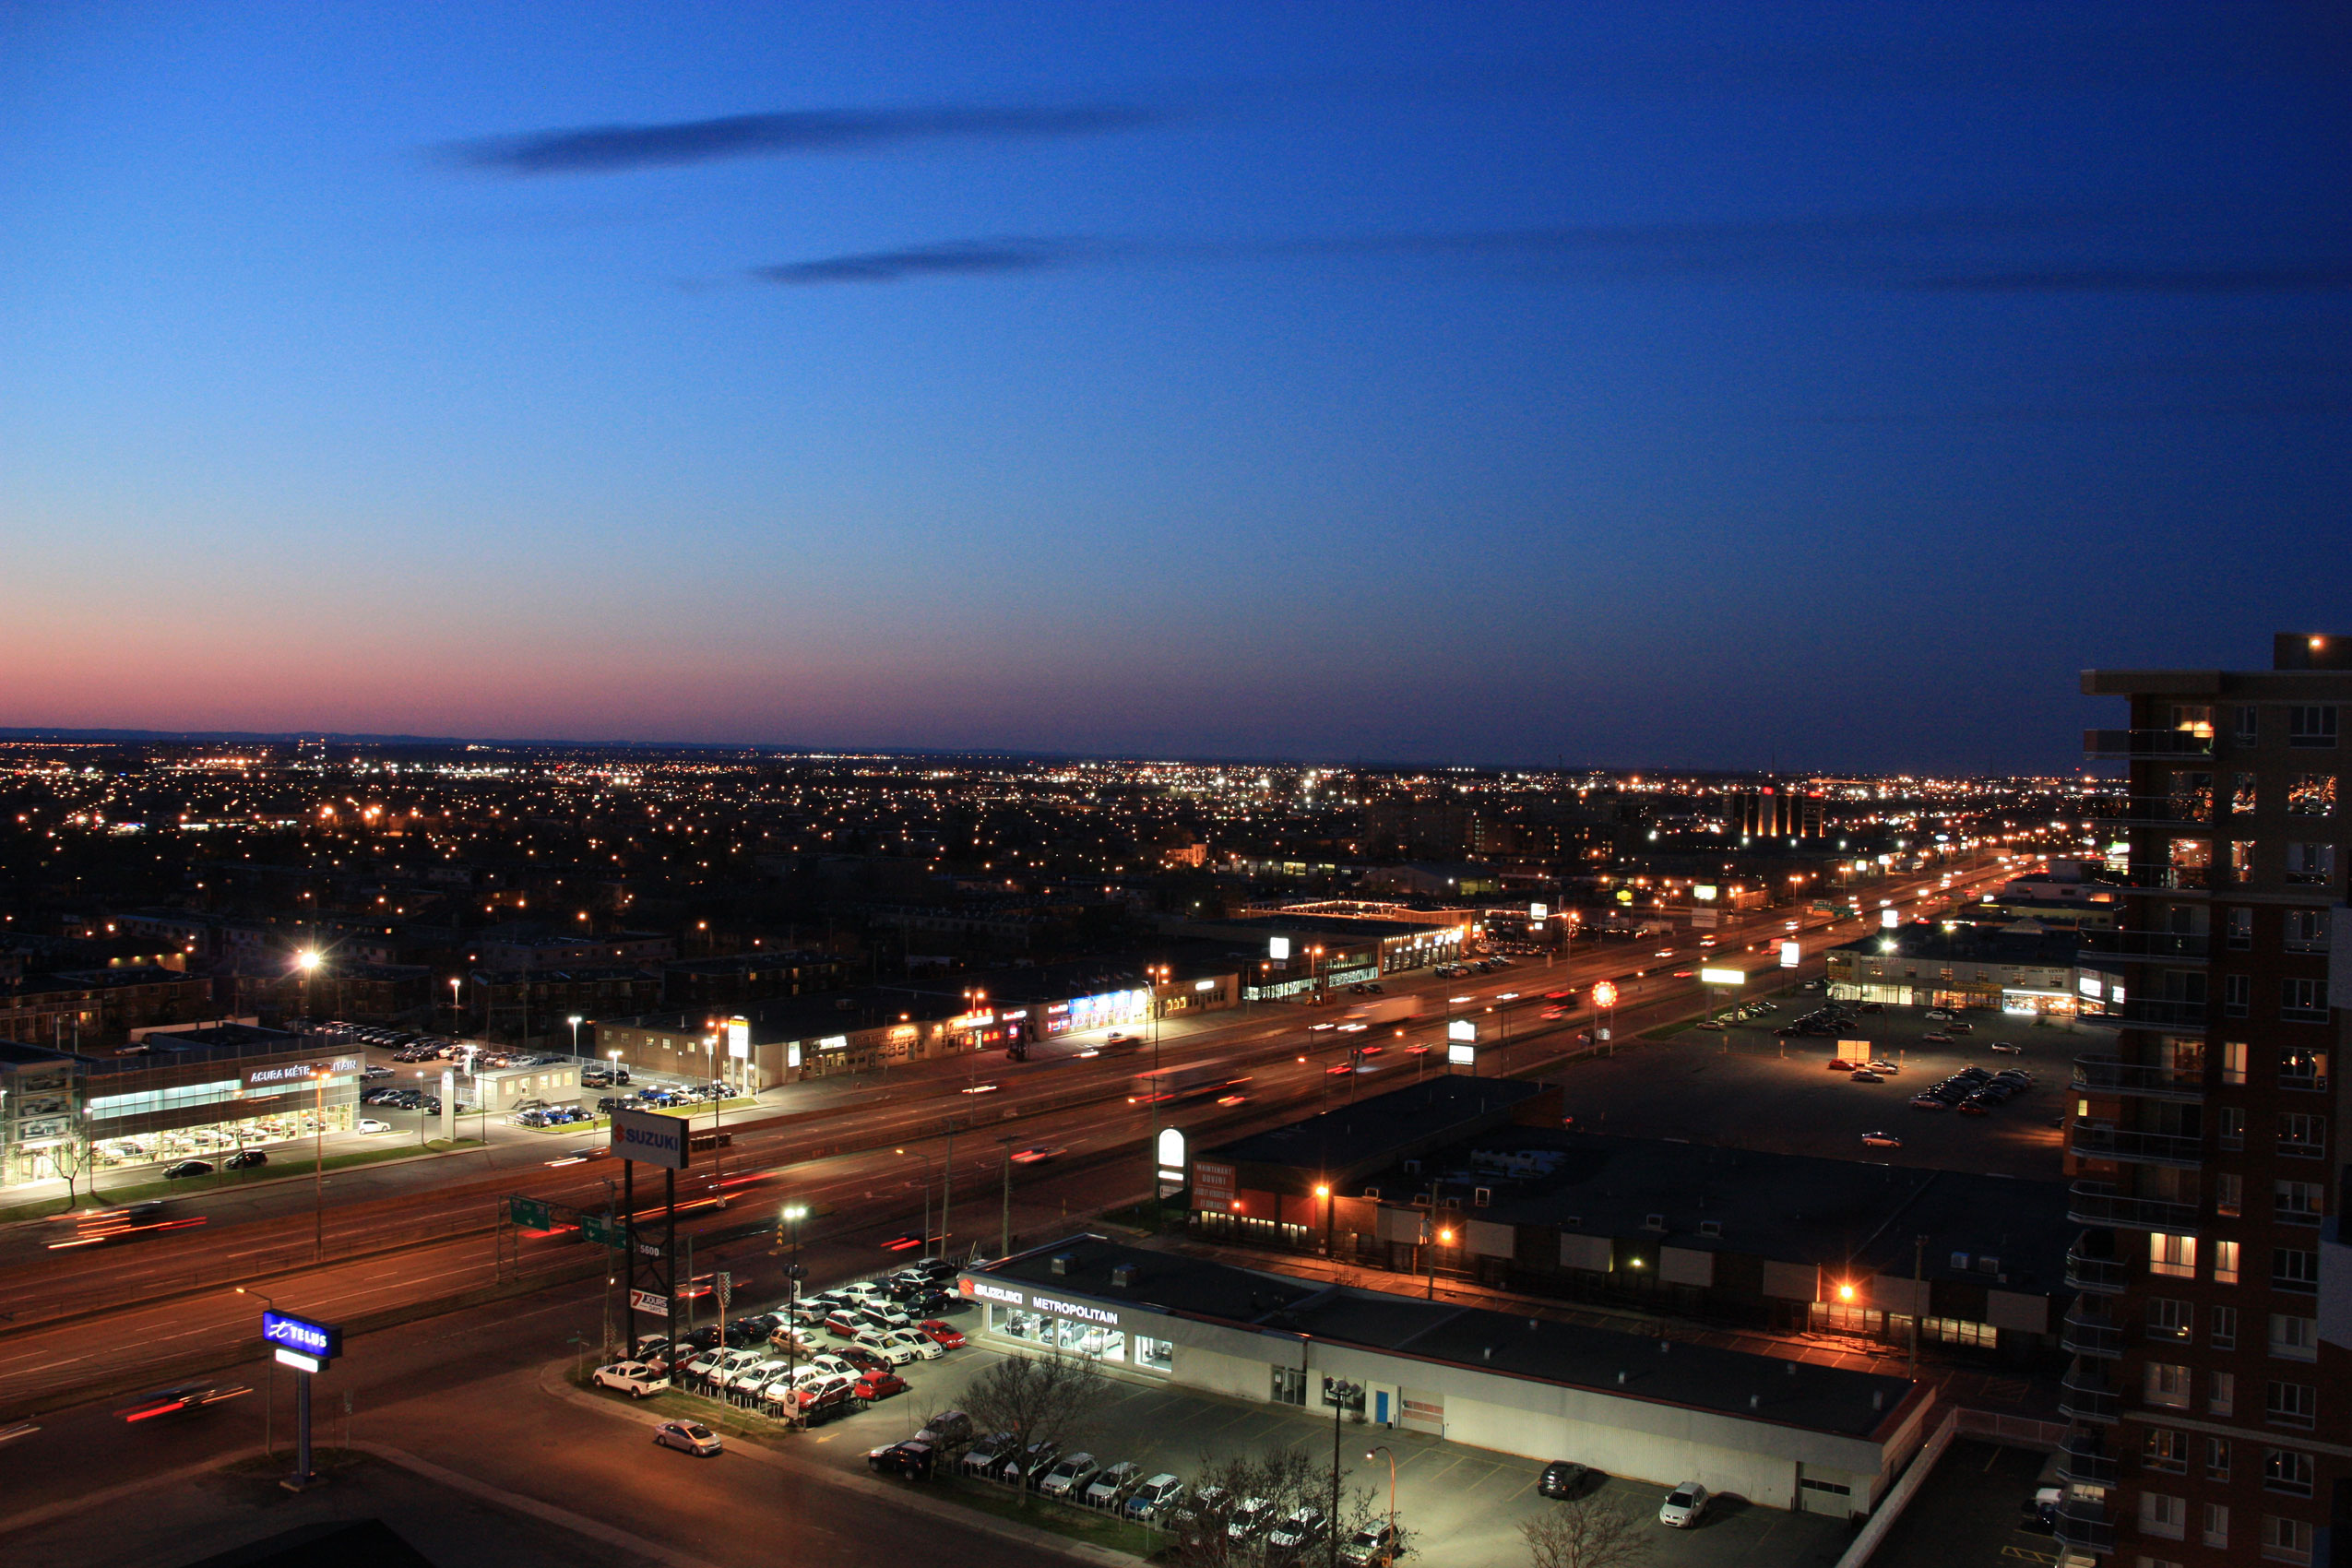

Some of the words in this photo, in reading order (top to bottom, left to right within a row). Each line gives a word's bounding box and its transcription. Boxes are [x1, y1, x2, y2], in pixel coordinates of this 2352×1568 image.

[250, 1069, 283, 1083] ACURA
[625, 1128, 679, 1151] SUZUKI
[640, 1244, 659, 1256] 5600
[631, 1290, 643, 1306] 7
[645, 1294, 668, 1307] JOURS
[974, 1284, 1023, 1304] SUZUKI
[1032, 1296, 1118, 1324] METROPOLITAIN
[290, 1325, 327, 1348] TELUS
